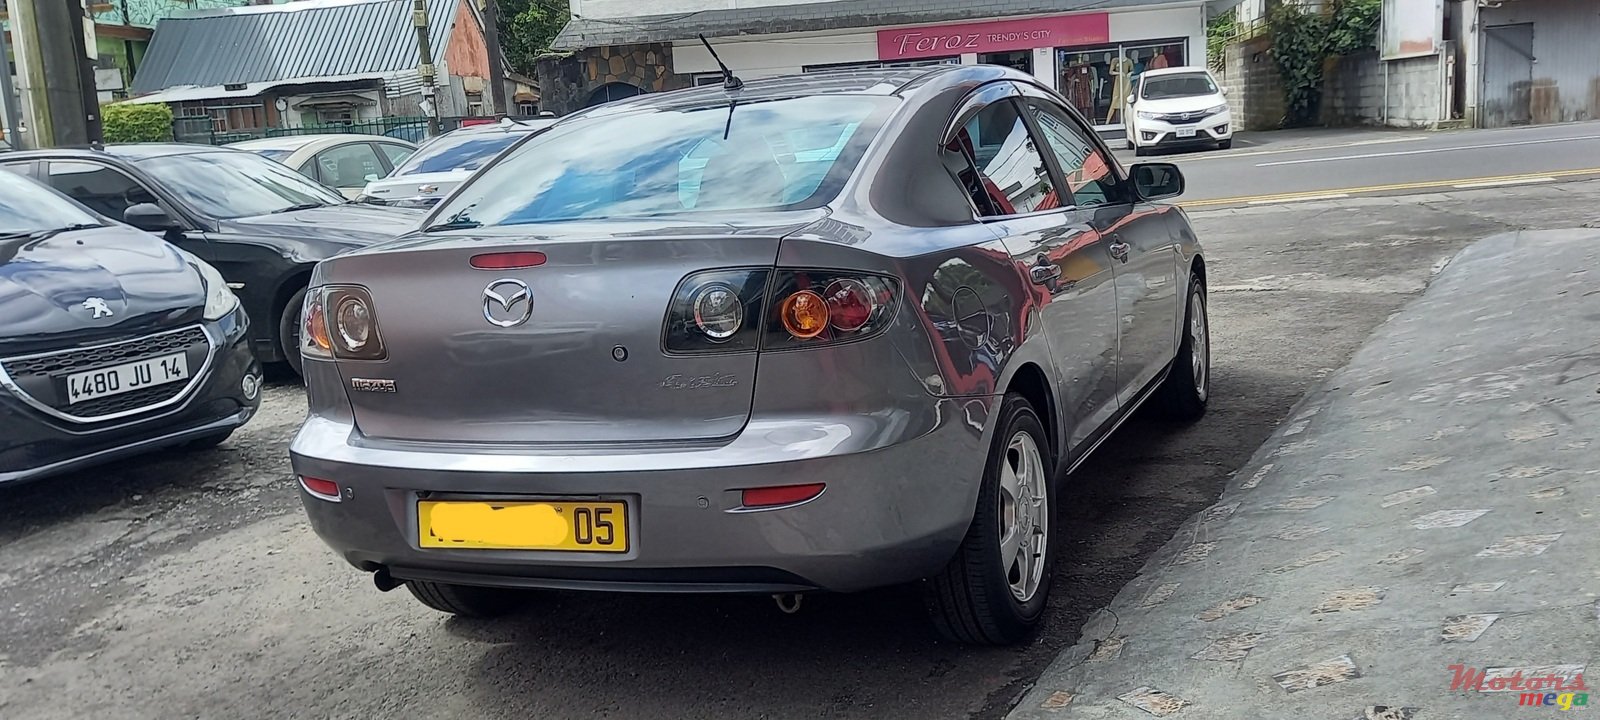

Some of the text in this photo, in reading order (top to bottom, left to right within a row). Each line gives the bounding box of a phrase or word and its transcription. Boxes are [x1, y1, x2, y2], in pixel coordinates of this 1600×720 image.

[893, 32, 980, 55] Feroz
[986, 31, 1029, 43] TRENDY'S
[1031, 30, 1051, 40] CITY
[71, 369, 120, 399] 4480
[129, 363, 152, 387] JU
[573, 507, 614, 545] 05
